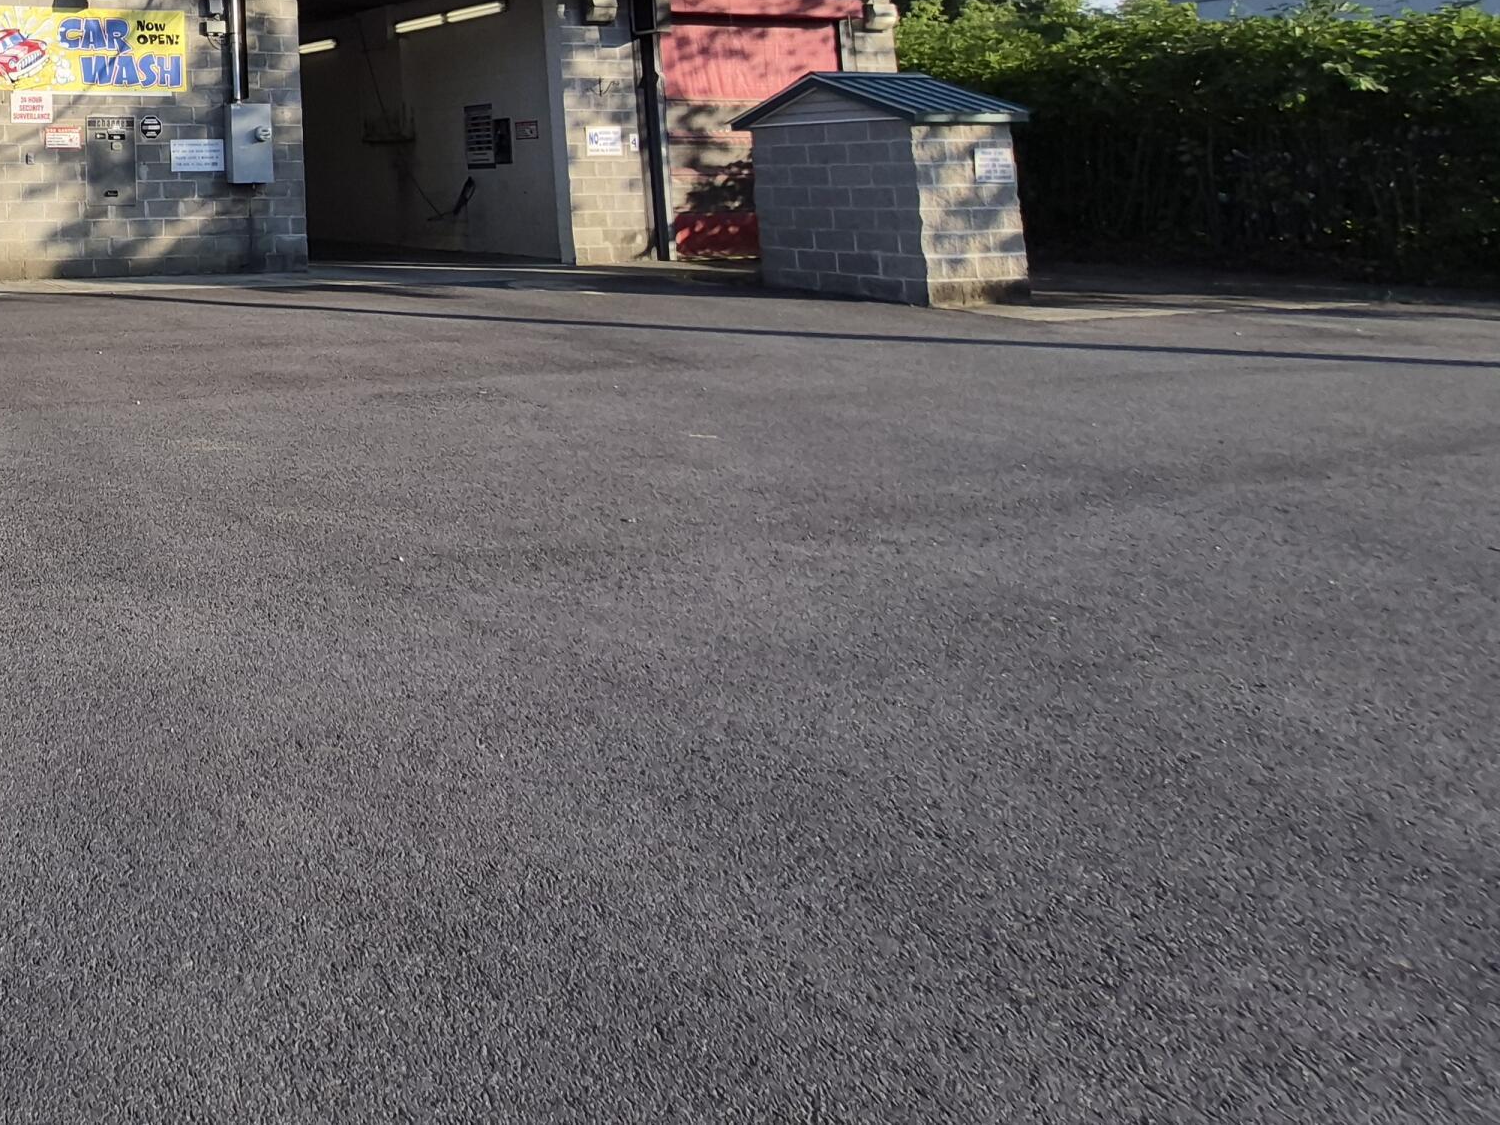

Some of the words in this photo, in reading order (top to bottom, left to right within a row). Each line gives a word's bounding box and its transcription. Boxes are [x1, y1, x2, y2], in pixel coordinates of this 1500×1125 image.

[59, 18, 132, 54] CAR
[136, 34, 180, 46] OPEN!
[80, 53, 182, 87] WASH
[13, 112, 51, 120] SURVEILLANCE
[589, 131, 599, 145] NO
[631, 138, 637, 147] 4
